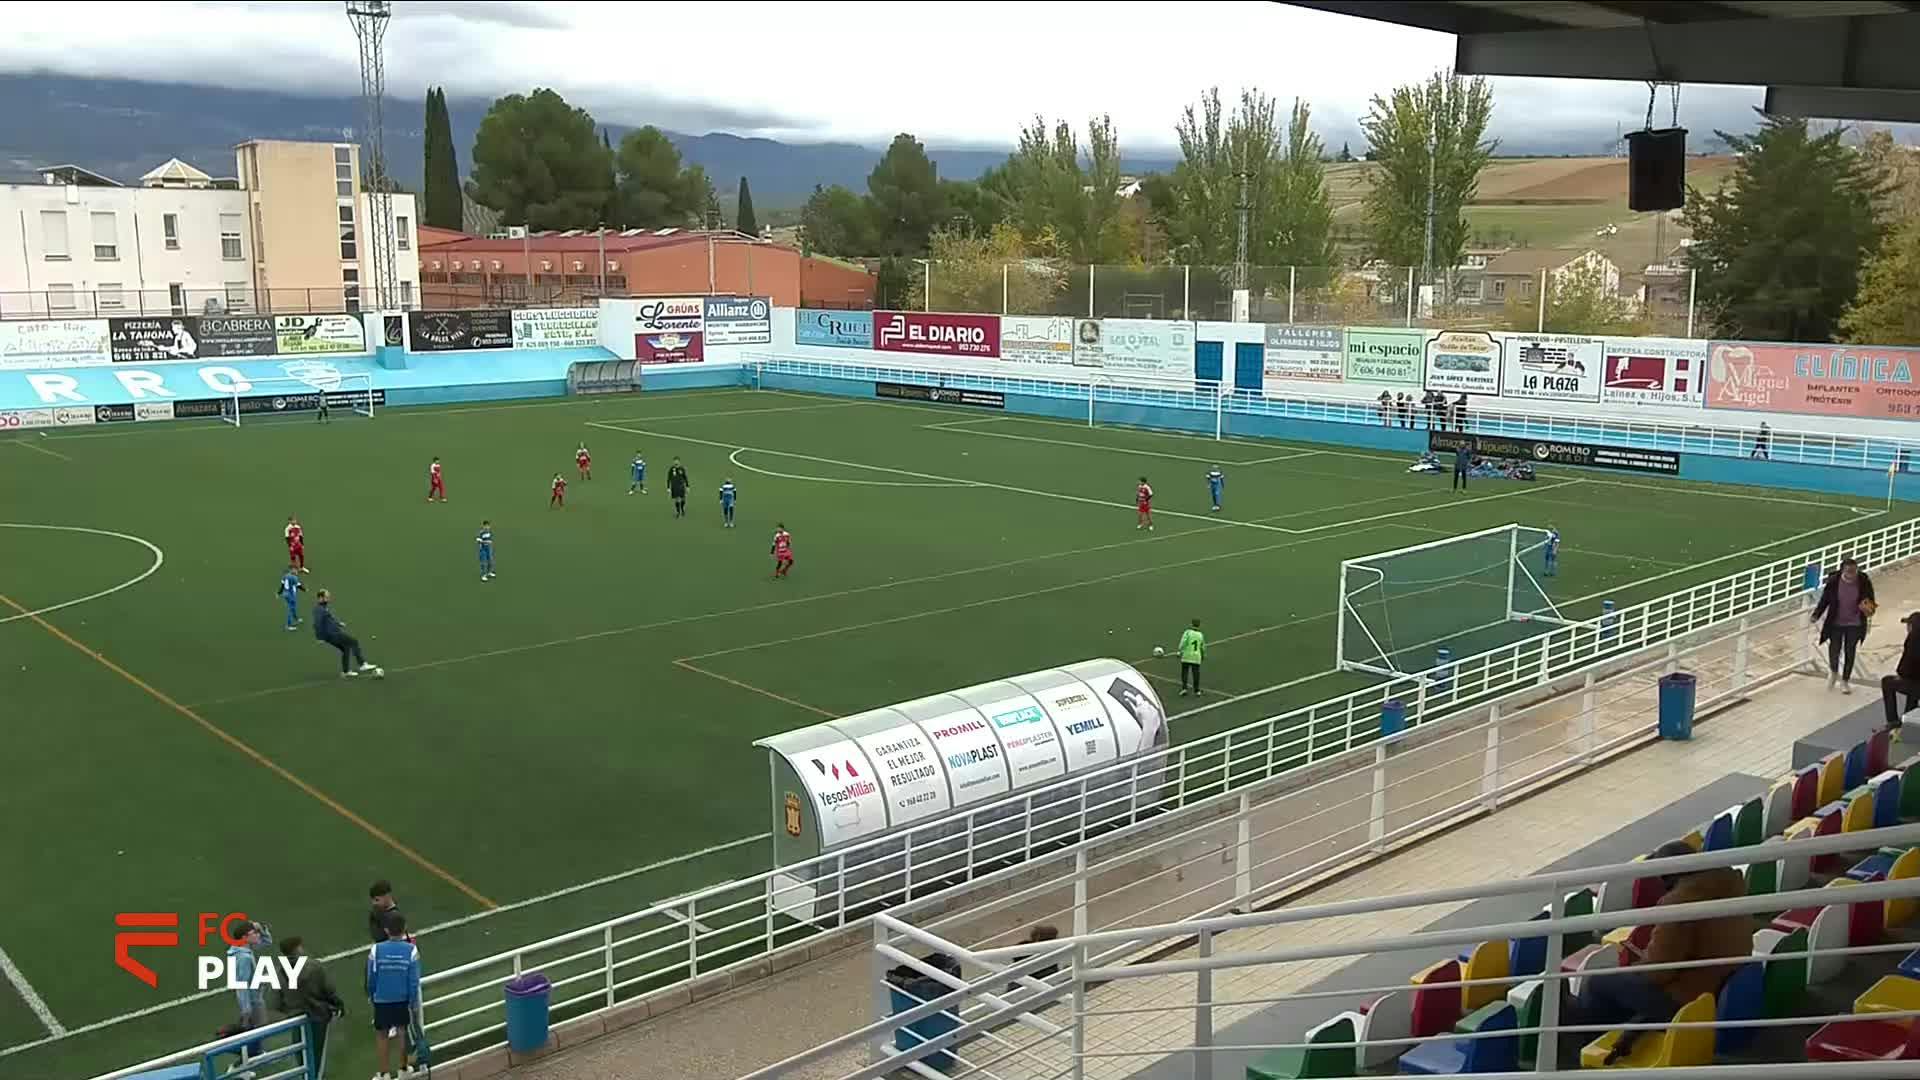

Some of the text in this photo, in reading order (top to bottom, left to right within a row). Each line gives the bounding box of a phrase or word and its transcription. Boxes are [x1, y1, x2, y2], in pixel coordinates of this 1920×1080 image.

[708, 303, 749, 317] Allianz
[280, 317, 304, 327] JD
[112, 330, 174, 340] LA TAHONA
[909, 325, 985, 343] EL DIARIO
[1278, 328, 1332, 338] TALLERES
[1315, 340, 1340, 348] HIJOS
[1350, 341, 1420, 357] mi espacio
[1606, 346, 1706, 358] EMPRESA CONSTRUCTORA
[1360, 366, 1374, 375] 606
[1376, 367, 1385, 375] 94
[1386, 367, 1396, 376] 80
[1794, 349, 1913, 385] CLÍNICA
[1523, 375, 1579, 392] LA PLAZA
[1729, 362, 1790, 392] Miguel
[1807, 383, 1861, 393] IMPLANTES
[1551, 444, 1591, 457] ROMERO
[1192, 641, 1198, 651] 1
[933, 720, 985, 739] PROMILL
[1066, 717, 1104, 735] YEMILL
[875, 738, 921, 756] GARANTIZA
[888, 751, 926, 770] EL MEJOR
[948, 744, 999, 768] NOVAPLAST
[890, 765, 936, 786] RESULTADO
